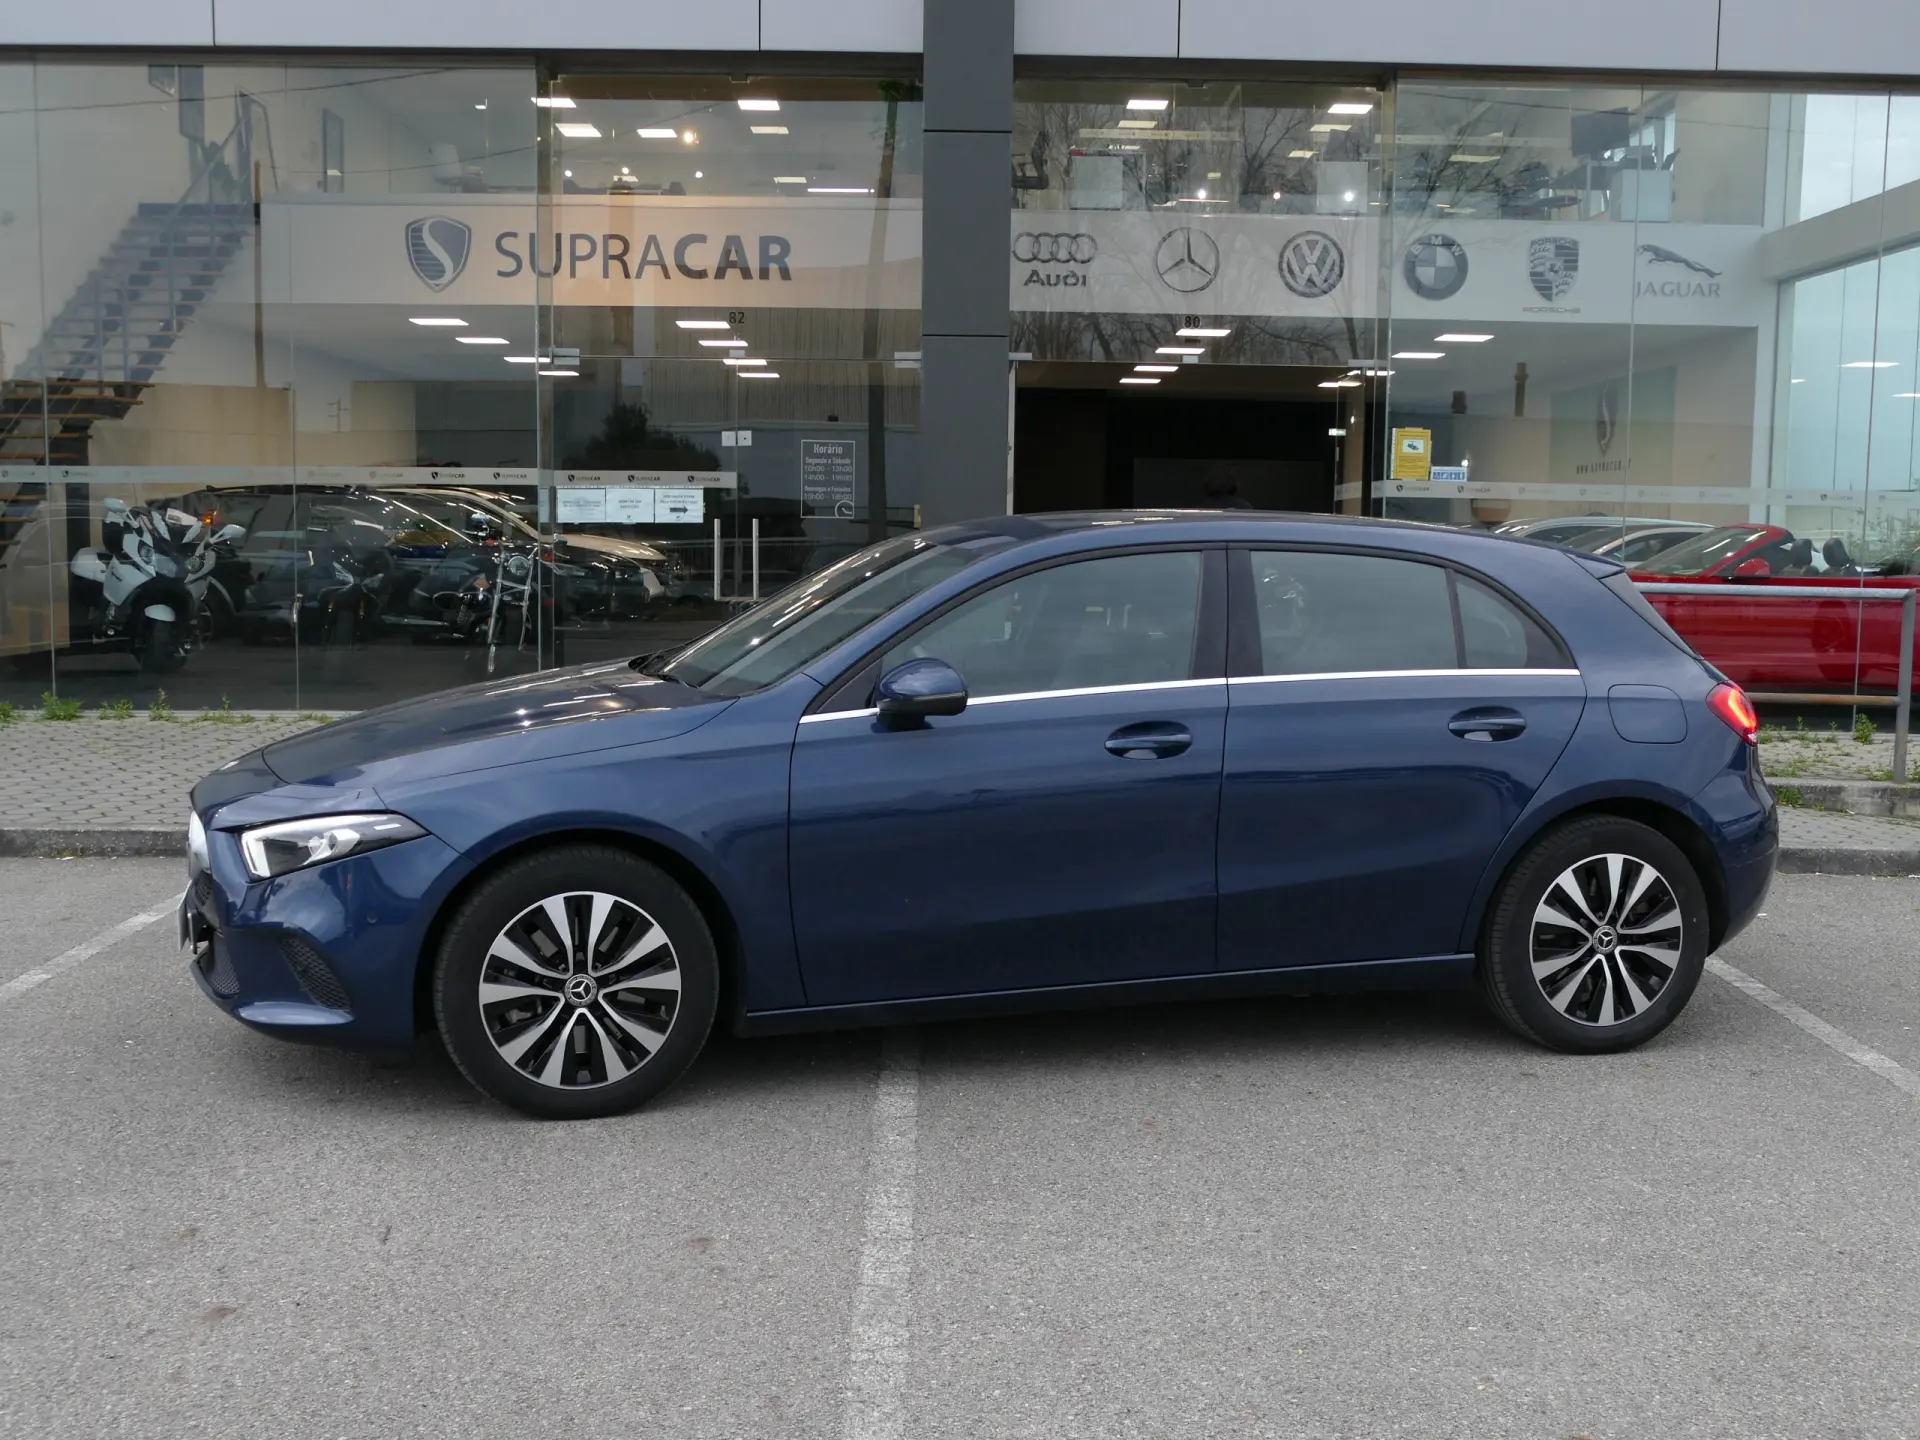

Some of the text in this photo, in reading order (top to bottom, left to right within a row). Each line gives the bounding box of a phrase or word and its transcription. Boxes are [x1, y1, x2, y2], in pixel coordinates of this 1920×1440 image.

[495, 231, 792, 281] SUPRACAR
[1023, 269, 1087, 287] Audi
[1635, 281, 1721, 298] JAGUAR
[1522, 306, 1582, 314] PORSCHE
[728, 311, 746, 325] 82
[1184, 315, 1201, 329] 80
[813, 444, 843, 454] Horário
